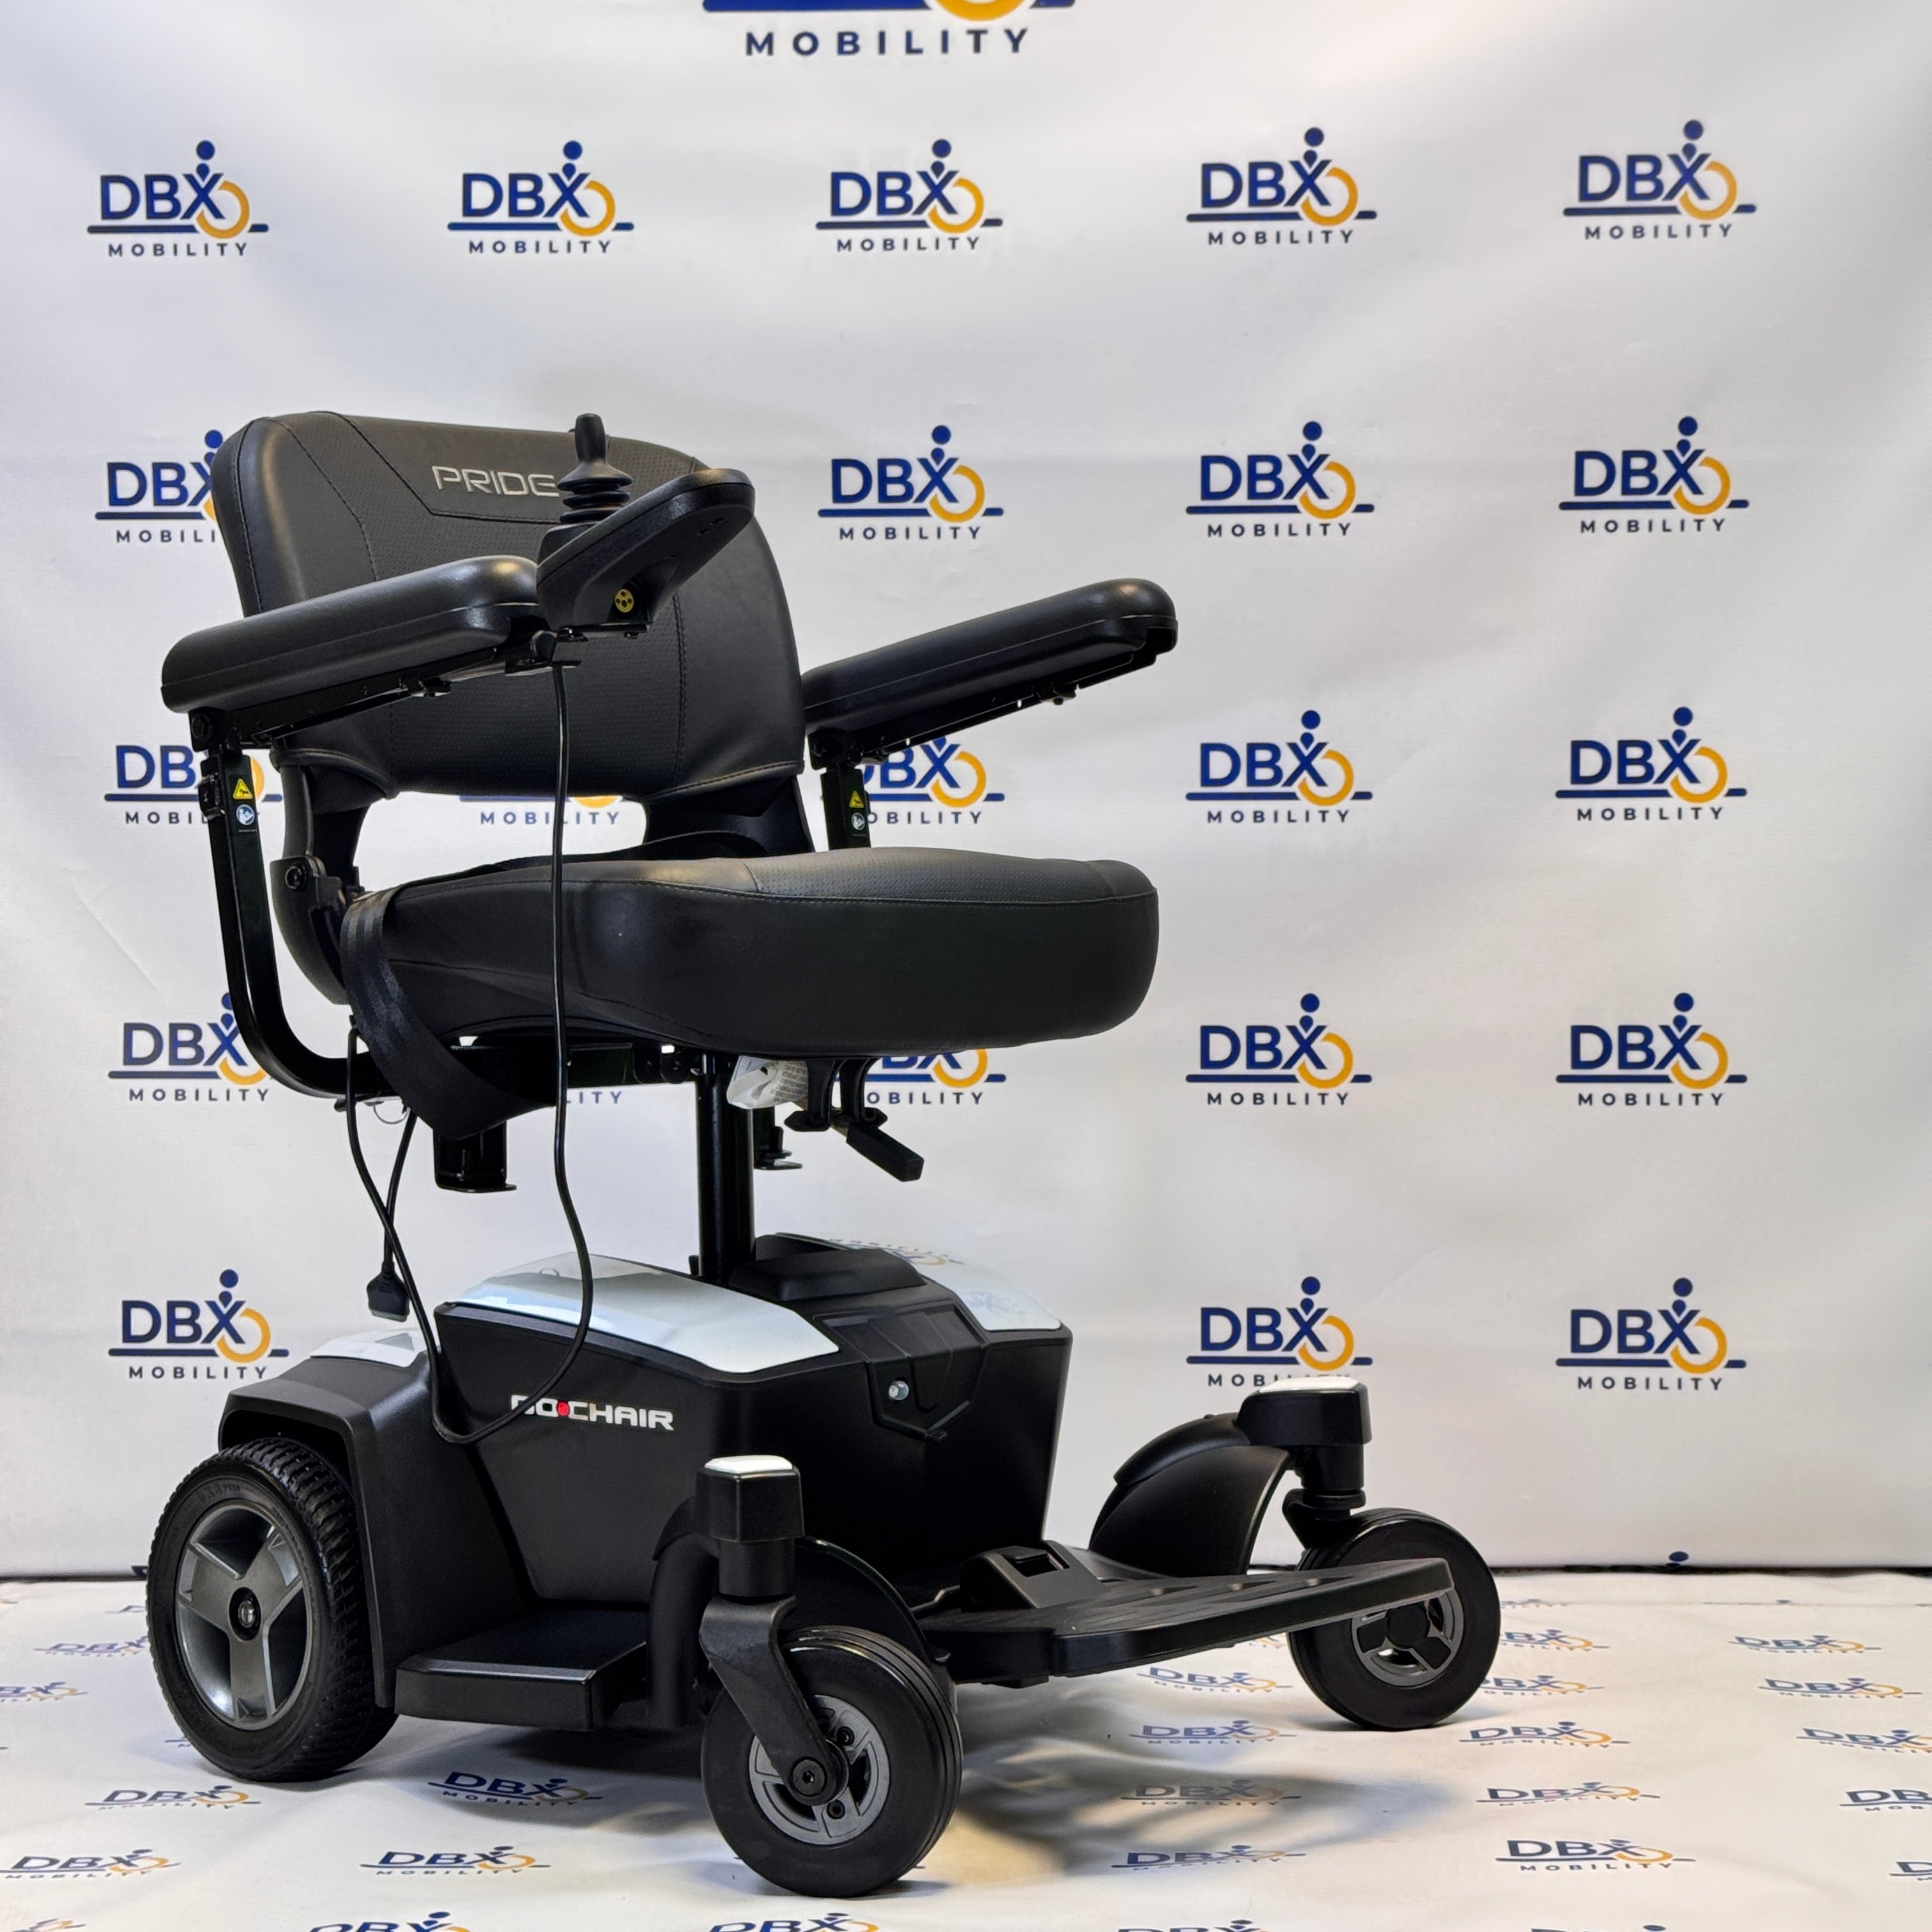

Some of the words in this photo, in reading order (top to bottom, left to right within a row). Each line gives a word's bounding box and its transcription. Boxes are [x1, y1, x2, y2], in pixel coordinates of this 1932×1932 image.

[746, 28, 1028, 56] MOBILITY
[1201, 159, 1333, 209] DBX
[1579, 153, 1712, 203] DBX
[100, 172, 225, 220] DBX
[461, 172, 592, 218] DBX
[831, 170, 960, 217] DBX
[1209, 229, 1354, 246] MOBILITY
[1584, 224, 1733, 240] MOBILITY
[109, 242, 249, 257] MOBILITY
[469, 240, 612, 254] MOBILITY
[837, 236, 980, 252] MOBILITY
[831, 457, 960, 503] DBX
[1200, 454, 1330, 501] DBX
[1573, 448, 1706, 496] DBX
[431, 465, 560, 498] PRIDE
[839, 526, 982, 540] MOBILITY
[1208, 522, 1352, 537] MOBILITY
[1580, 518, 1726, 533] MOBILITY
[116, 530, 216, 543] MOBILI
[116, 745, 197, 789] DB
[1200, 742, 1329, 788] DBX
[1570, 738, 1701, 785] DBX
[480, 811, 620, 825] MOBIITY
[867, 811, 982, 824] OBILITY
[1207, 809, 1351, 824] MOBILITY
[1577, 806, 1724, 822] MOBILITY
[123, 1022, 248, 1066] DBX
[1200, 1025, 1328, 1070] DBX
[1570, 1025, 1702, 1070] DBX
[129, 1088, 270, 1101] MOBILITY
[866, 1092, 983, 1105] OBILITY
[1207, 1092, 1350, 1106] MOBILITY
[1578, 1092, 1724, 1107] MOBILITY
[121, 1300, 246, 1344] DBX
[1200, 1307, 1328, 1352] DBX
[1570, 1308, 1700, 1354] DBX
[129, 1366, 268, 1379] MOBILITY
[1577, 1376, 1724, 1390] MOBILITY
[1150, 1667, 1255, 1686] DBX
[1143, 1724, 1256, 1736] DBX
[1470, 1726, 1588, 1740] DBX
[444, 1771, 570, 1798] DBX
[1846, 1788, 1932, 1803] DB
[1507, 1839, 1646, 1857] DBX
[378, 1851, 516, 1865] DBX
